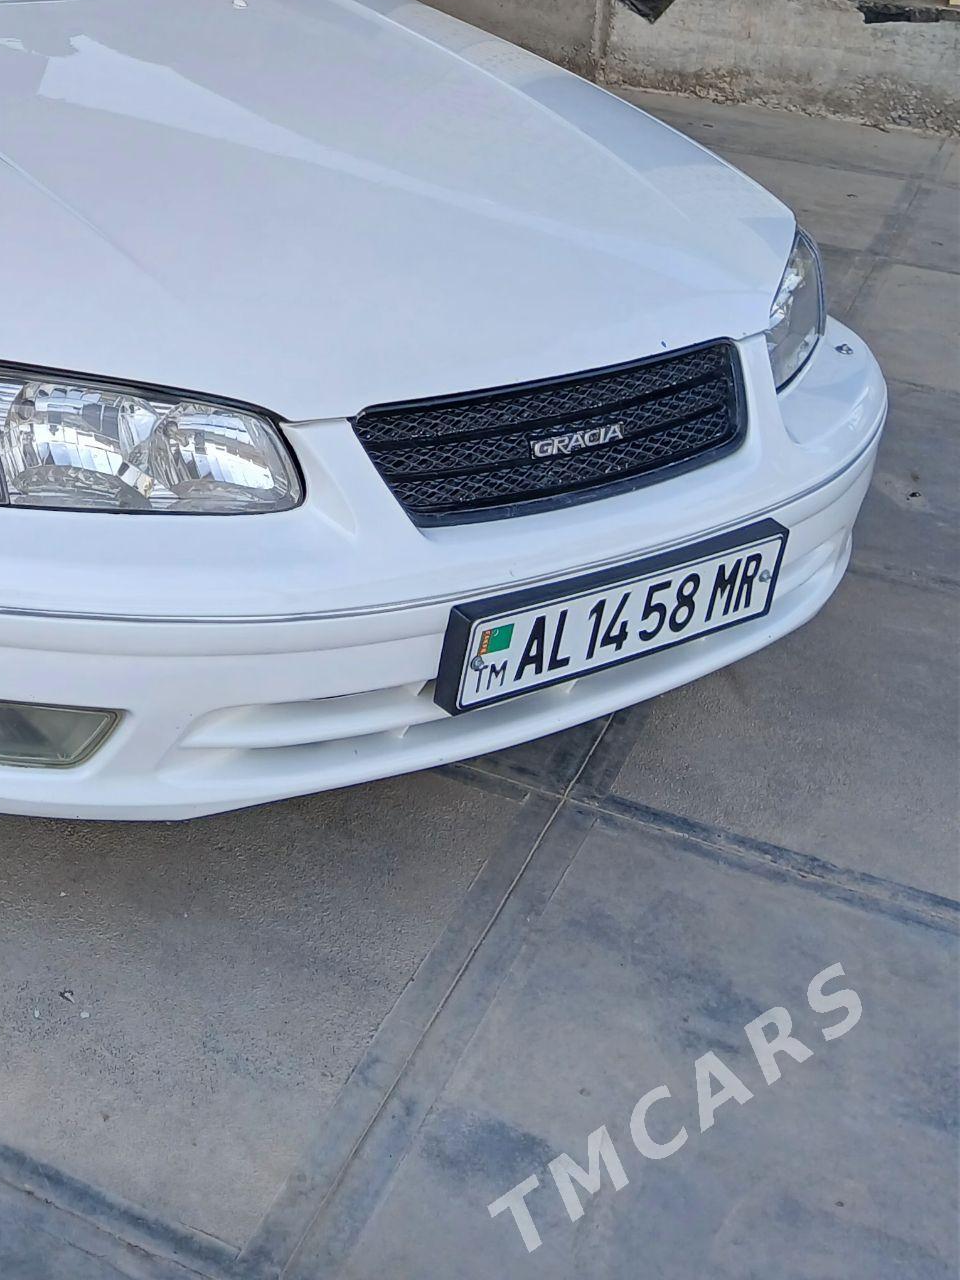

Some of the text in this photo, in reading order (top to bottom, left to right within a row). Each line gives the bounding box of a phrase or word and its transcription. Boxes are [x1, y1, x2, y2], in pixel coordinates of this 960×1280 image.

[533, 421, 624, 458] GRACIA
[513, 608, 571, 682] AL
[704, 552, 763, 623] MR
[475, 660, 507, 693] TM
